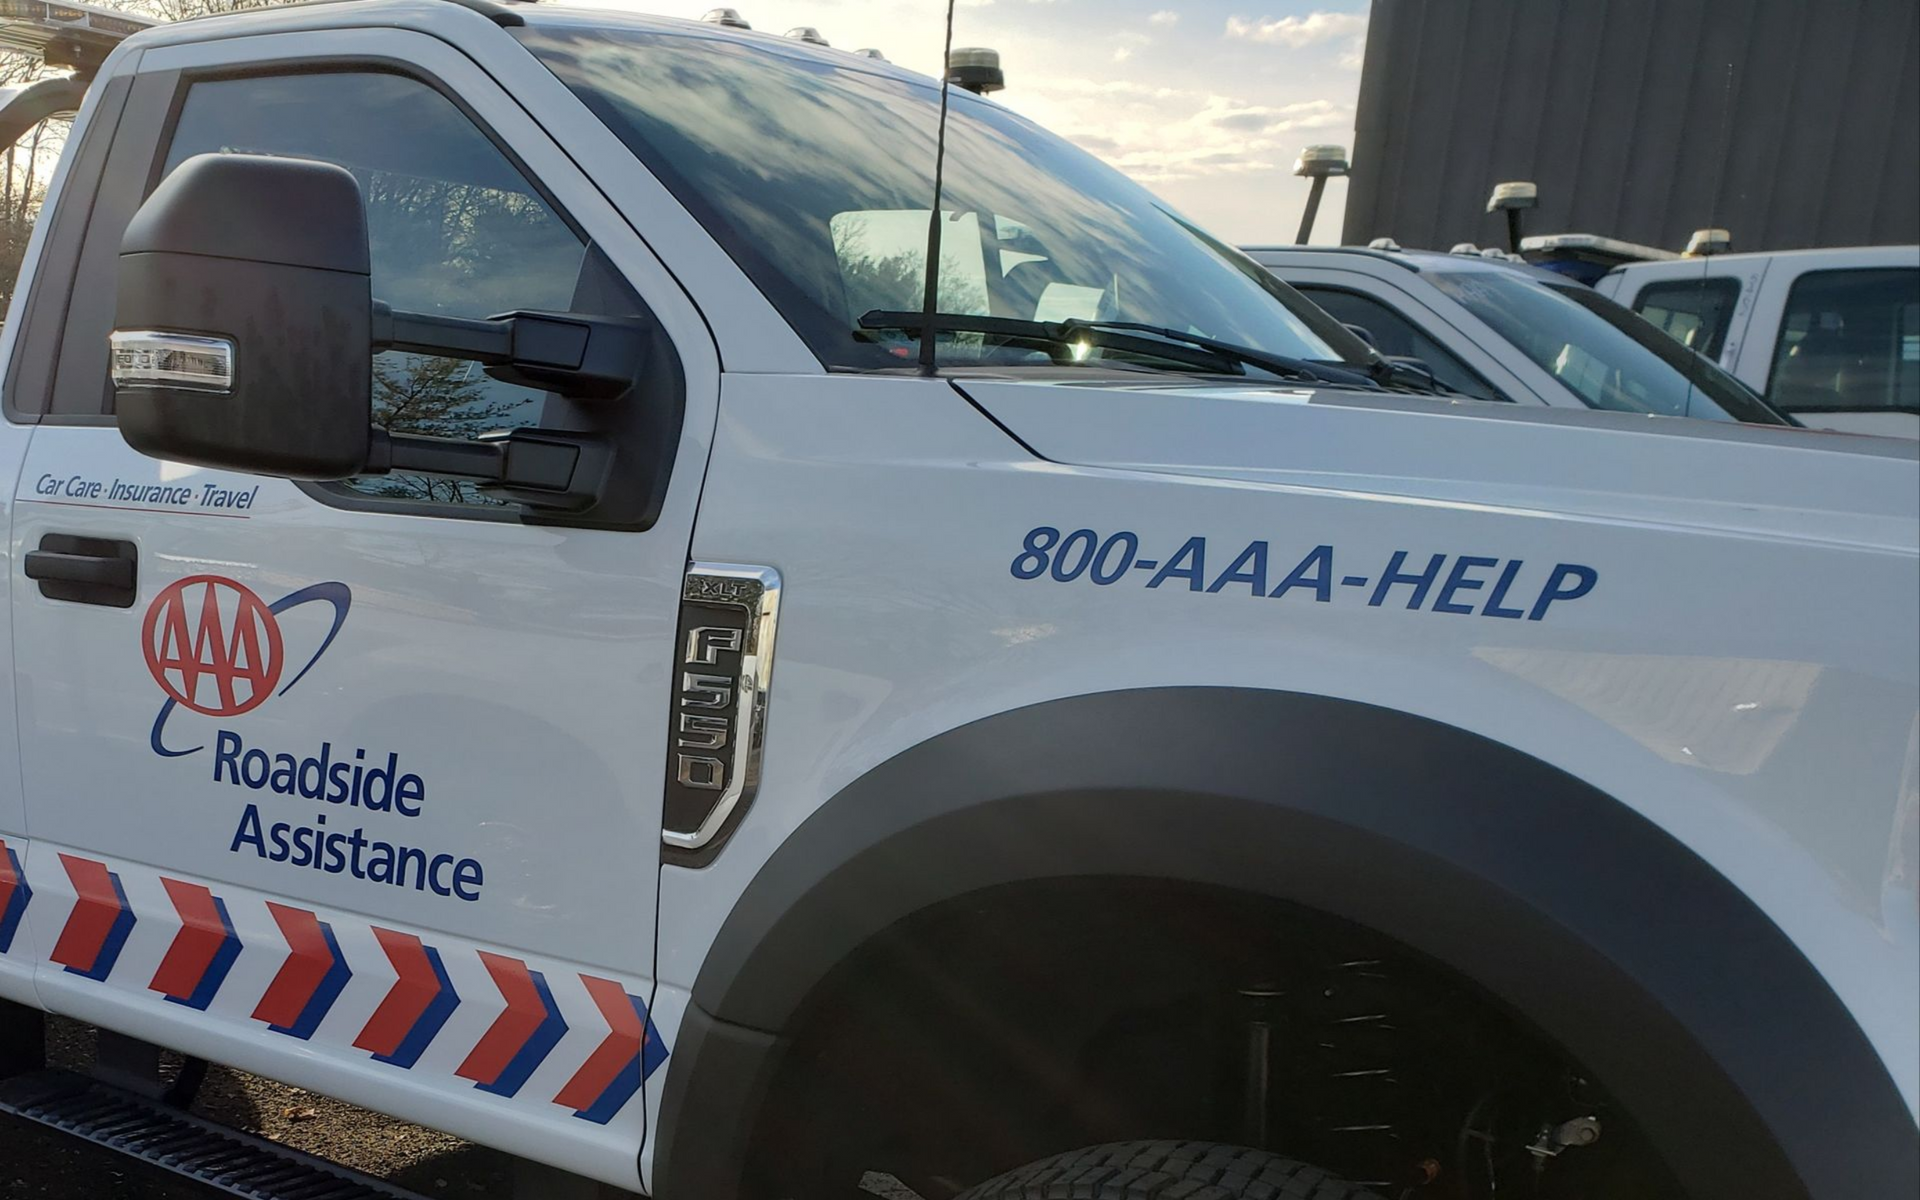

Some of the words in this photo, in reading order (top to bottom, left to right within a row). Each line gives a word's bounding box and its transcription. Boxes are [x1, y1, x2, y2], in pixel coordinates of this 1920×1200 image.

[36, 473, 64, 495] Car
[65, 475, 101, 499] Care
[108, 478, 191, 505] Insurance
[200, 484, 259, 509] Travel
[701, 581, 746, 596] XLT
[1010, 526, 1598, 621] 800-AAA-HELP
[153, 580, 270, 712] AAA
[213, 729, 425, 817] Roadside
[230, 803, 484, 901] Assistance
